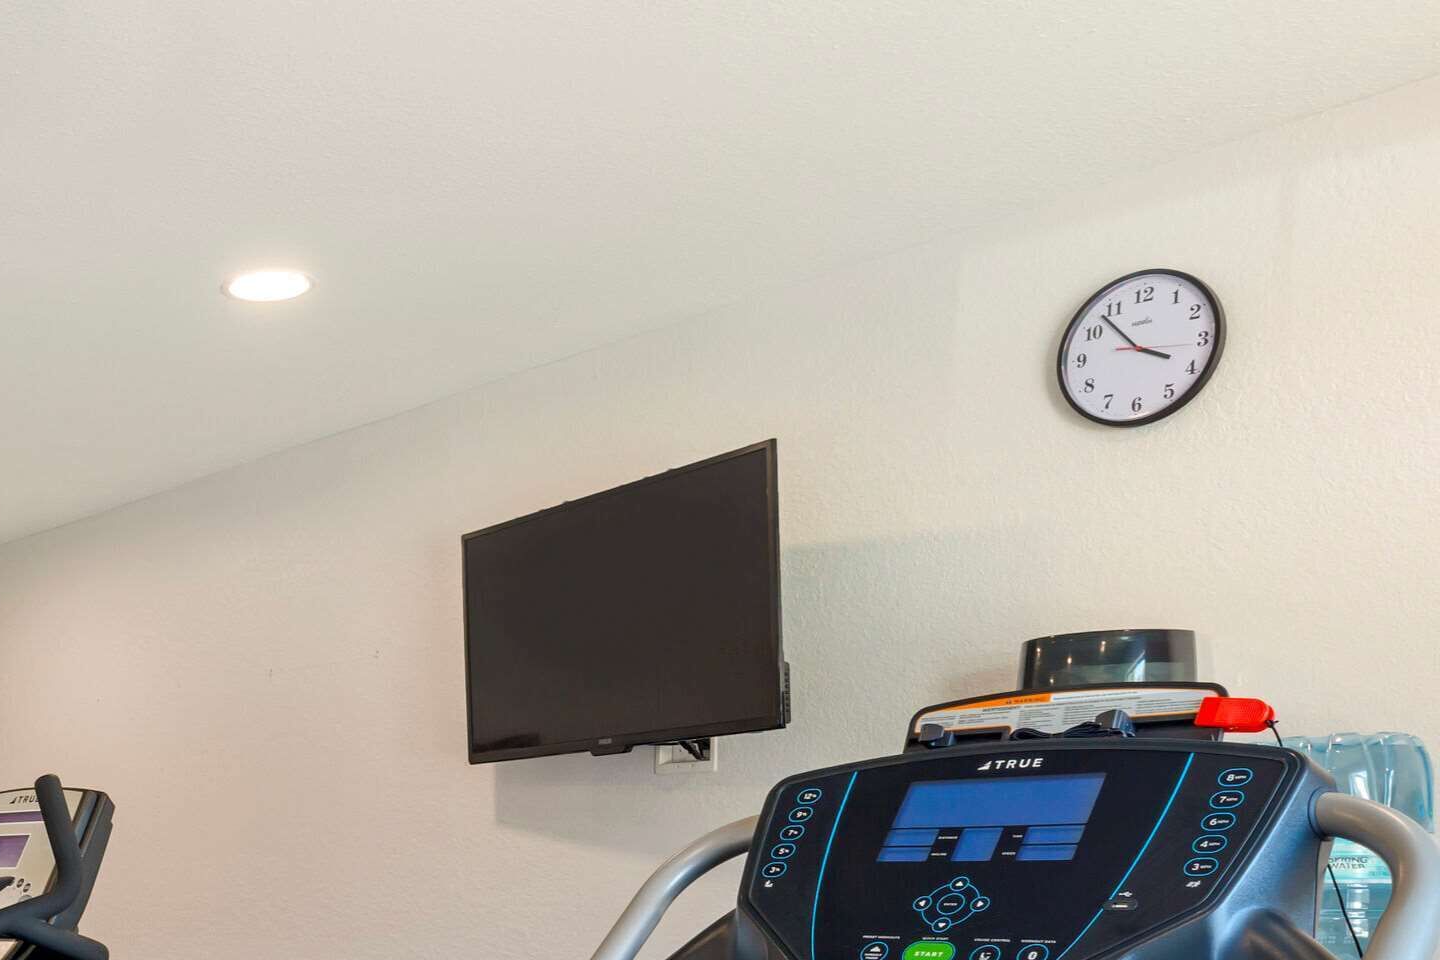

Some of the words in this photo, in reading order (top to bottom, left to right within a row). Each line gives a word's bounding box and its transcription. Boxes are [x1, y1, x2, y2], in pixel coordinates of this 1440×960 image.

[1133, 286, 1154, 304] 12
[1172, 288, 1180, 304] 1
[1106, 301, 1123, 317] 11
[1188, 304, 1202, 320] 2
[1085, 325, 1103, 342] 10
[1196, 331, 1210, 347] 3
[1076, 353, 1088, 369] 9
[1185, 359, 1198, 376] 4
[1084, 378, 1095, 393] 8
[1164, 383, 1175, 400] 5
[1104, 394, 1114, 410] 7
[1131, 396, 1142, 412] 6
[995, 758, 1044, 770] TRUE
[1226, 774, 1235, 782] 8
